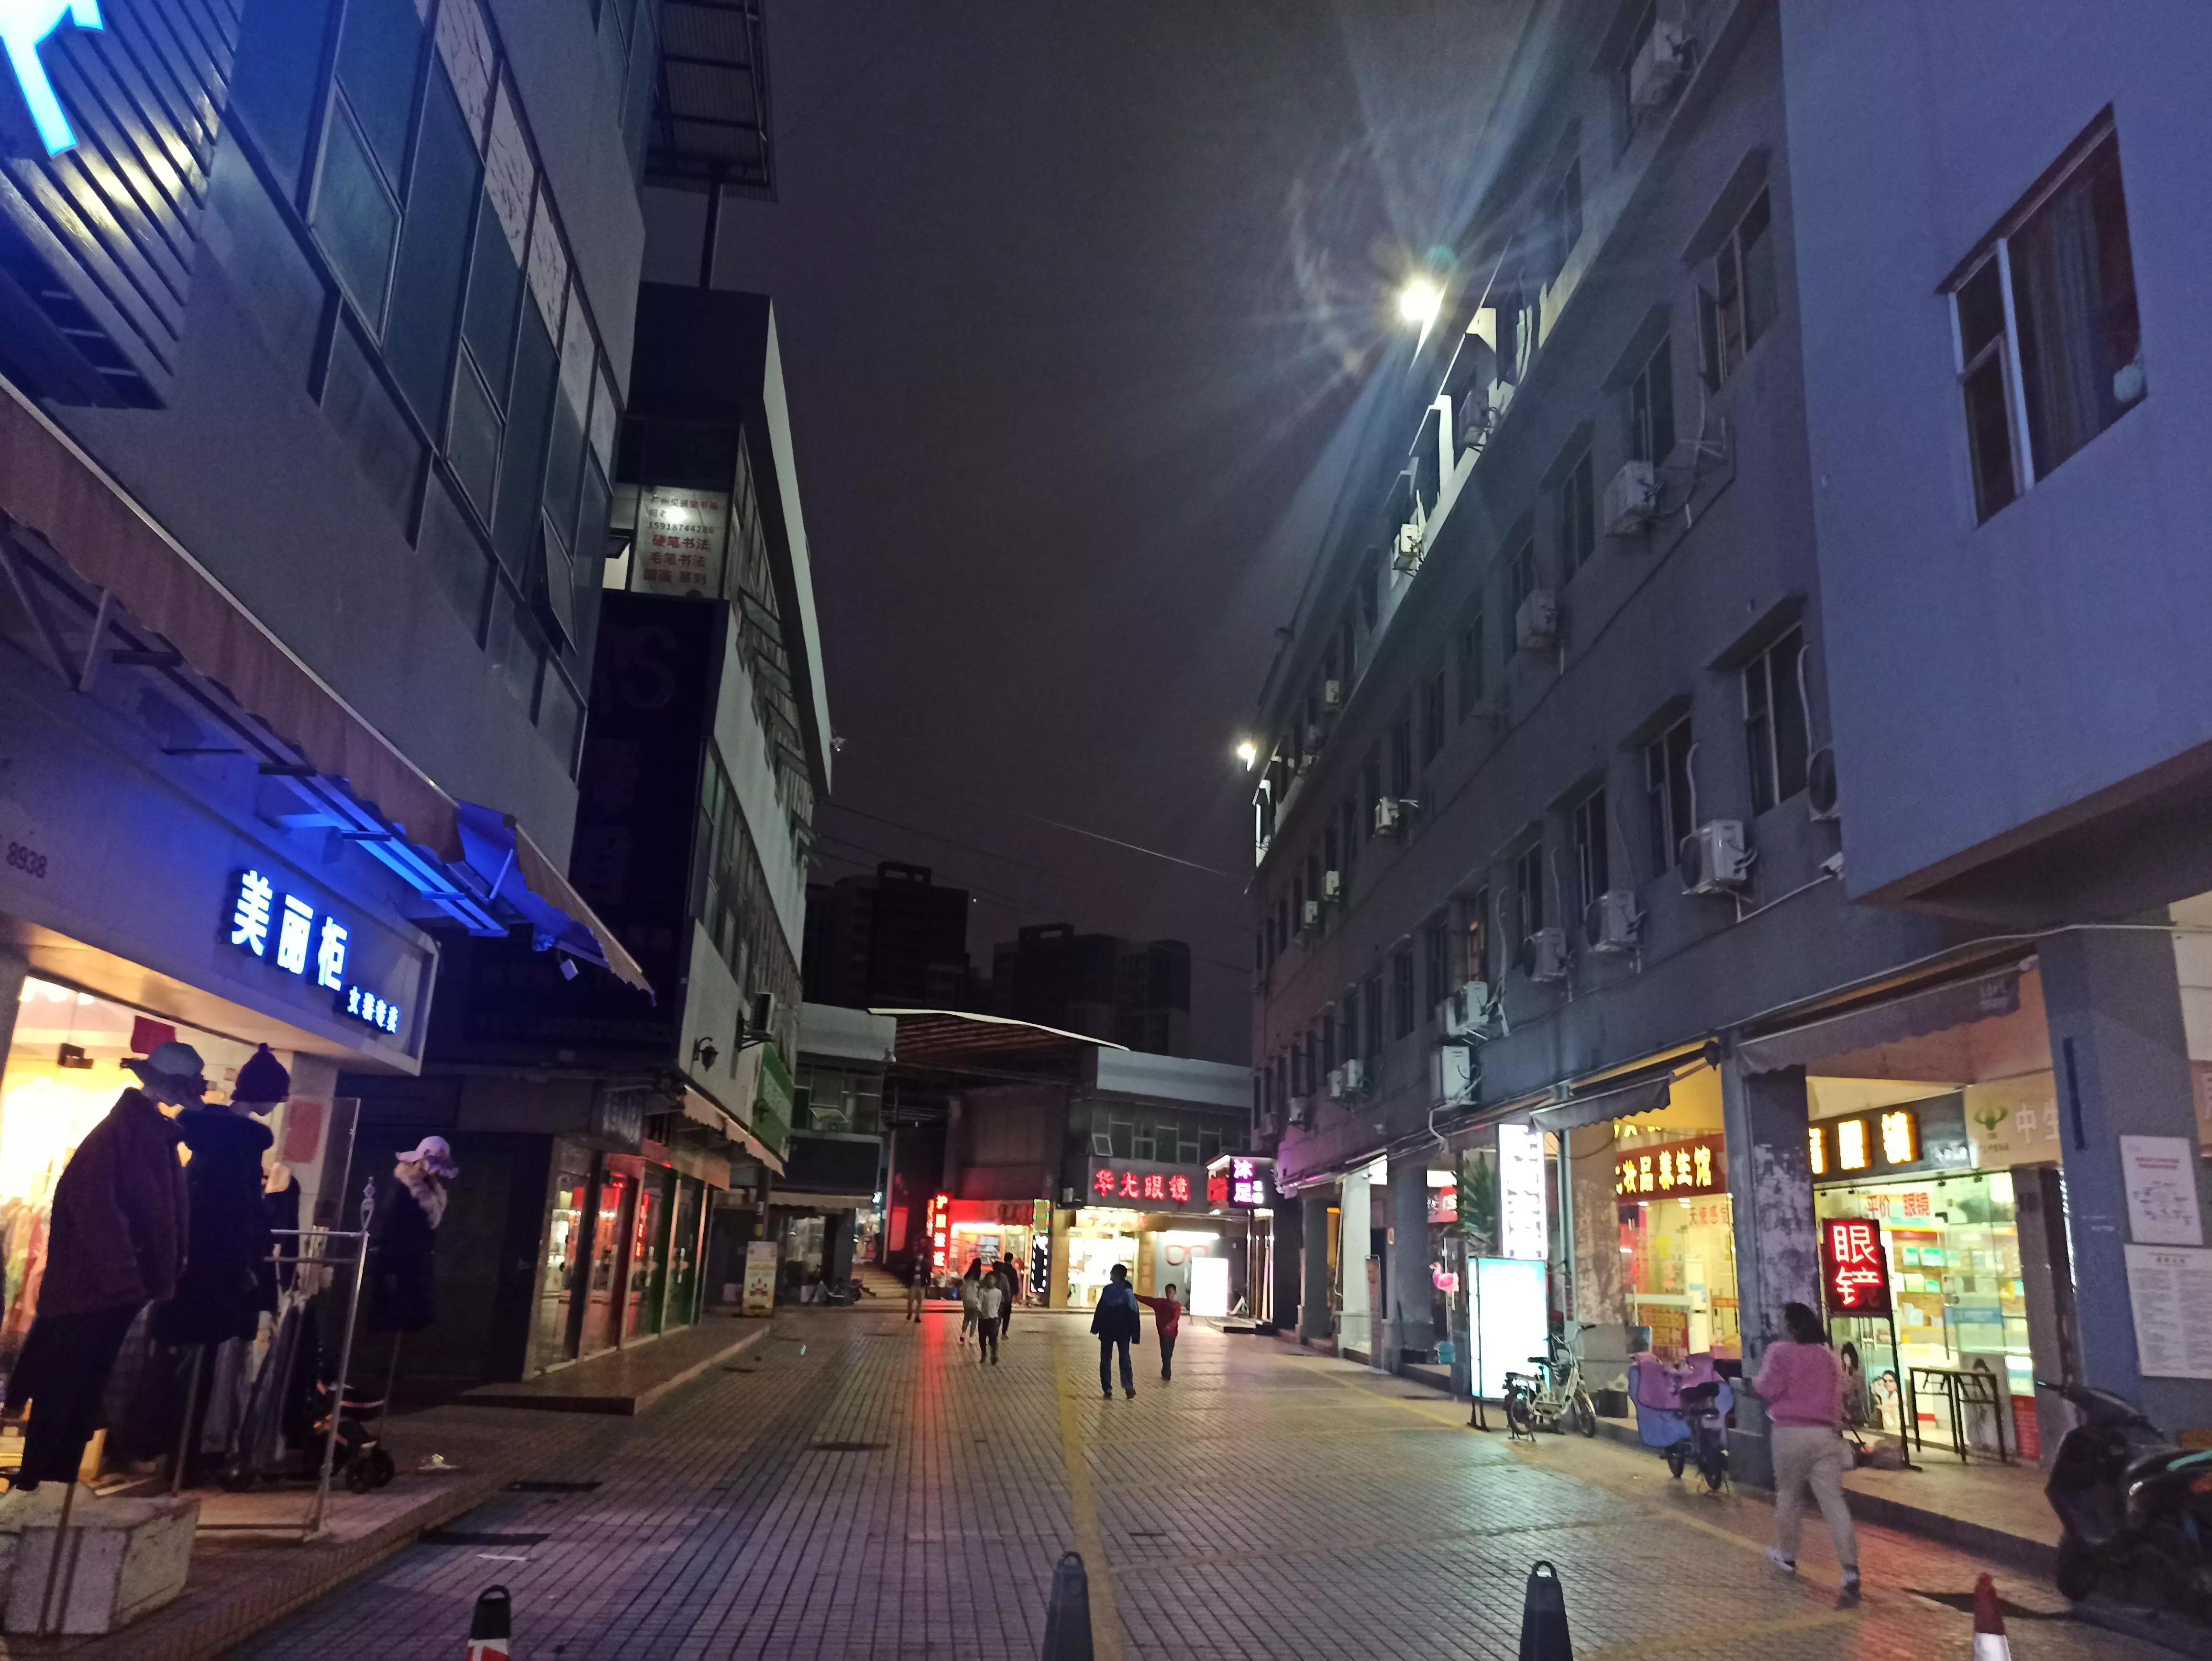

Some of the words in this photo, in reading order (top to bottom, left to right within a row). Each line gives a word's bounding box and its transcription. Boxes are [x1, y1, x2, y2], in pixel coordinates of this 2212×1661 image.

[649, 552, 706, 567] 毛笔书法
[652, 535, 709, 551] 硬笔书法
[6, 842, 48, 879] 8938
[231, 870, 348, 991] 美丽柜
[1233, 1159, 1253, 1202] 沐足
[1833, 1225, 1880, 1307] 眼镜
